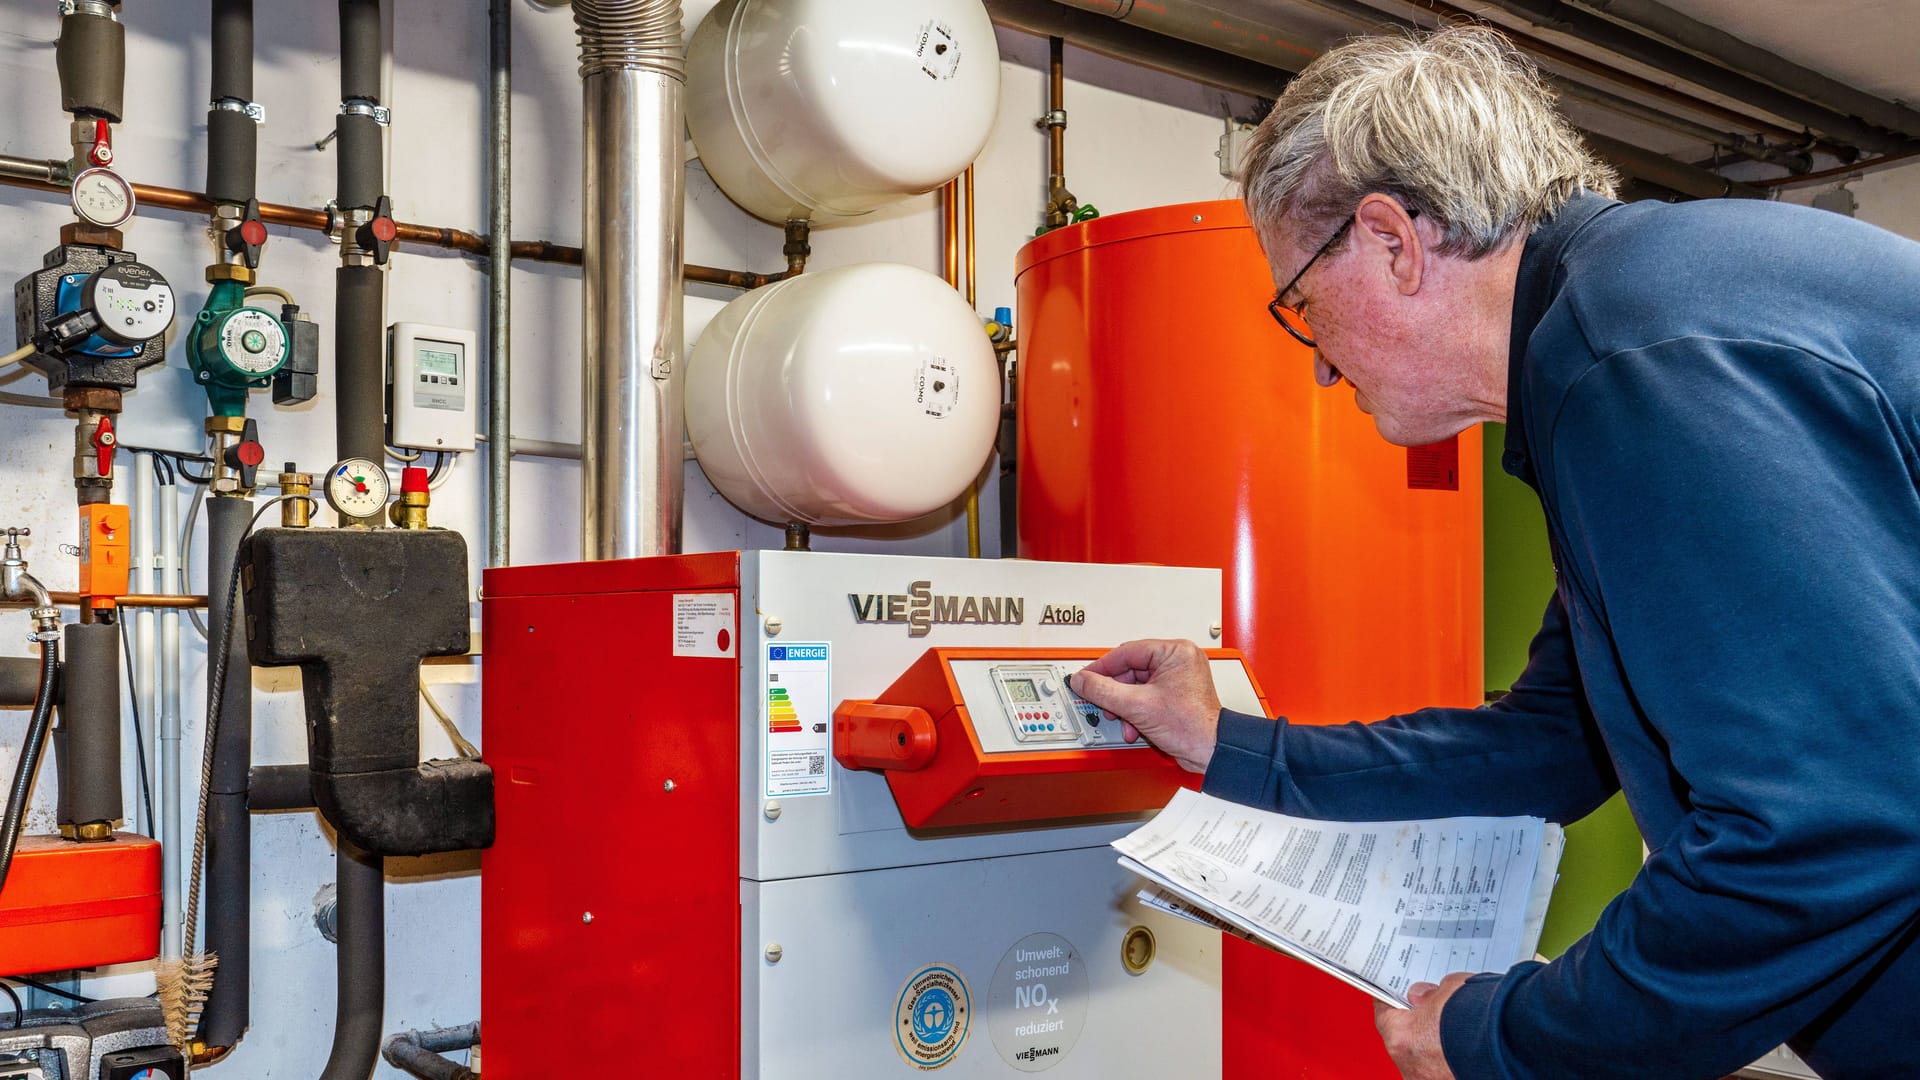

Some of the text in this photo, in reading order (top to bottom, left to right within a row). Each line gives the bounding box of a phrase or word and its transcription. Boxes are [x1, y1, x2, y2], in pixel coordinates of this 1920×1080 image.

[917, 32, 928, 57] COSMO
[917, 376, 926, 403] COSMO
[848, 580, 1086, 637] VIESSMANN Atola
[788, 648, 826, 658] ENERGIE
[1016, 945, 1064, 962] Umwelt-
[1015, 961, 1070, 981] schonend
[912, 973, 955, 991] Umweltzeichen
[907, 980, 961, 1011] Gas-Spezialheizkessel
[908, 1021, 961, 1053] weil emissionsarm und
[1015, 1019, 1065, 1037] reduziert
[915, 1040, 957, 1060] energiesparend
[1015, 1046, 1060, 1062] VIESSMANN
